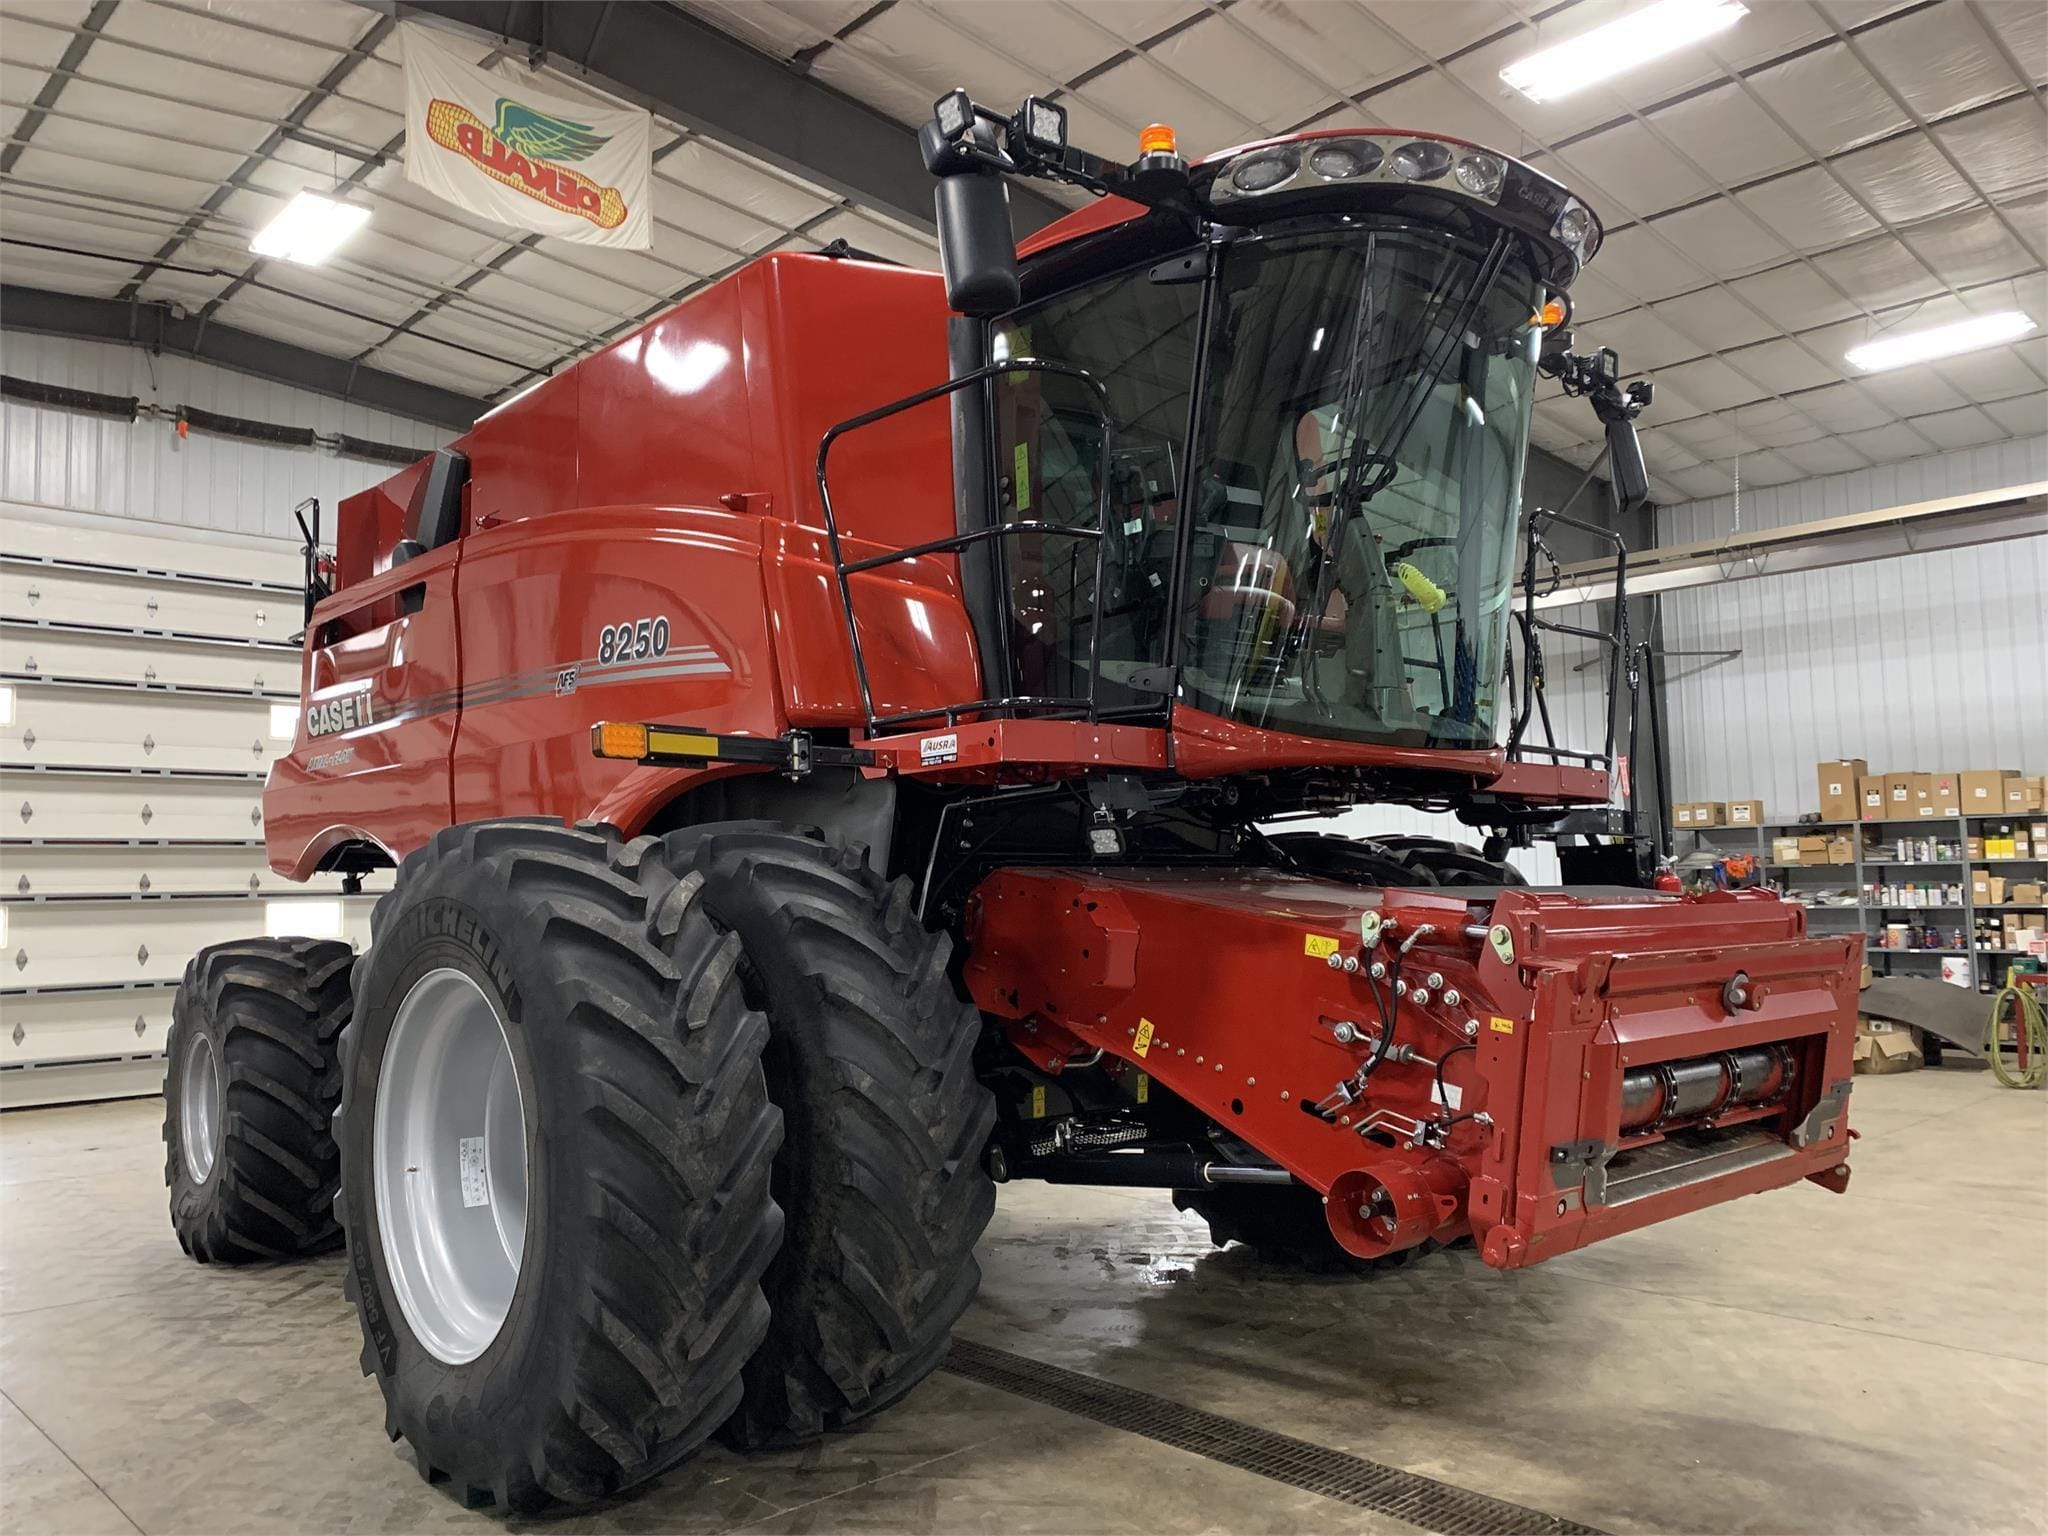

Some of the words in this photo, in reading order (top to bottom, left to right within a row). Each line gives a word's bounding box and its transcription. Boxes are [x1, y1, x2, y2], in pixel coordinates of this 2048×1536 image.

[598, 615, 670, 667] 8250
[556, 669, 577, 690] AFS
[307, 697, 355, 737] CASE
[401, 903, 516, 996] MICHELIN
